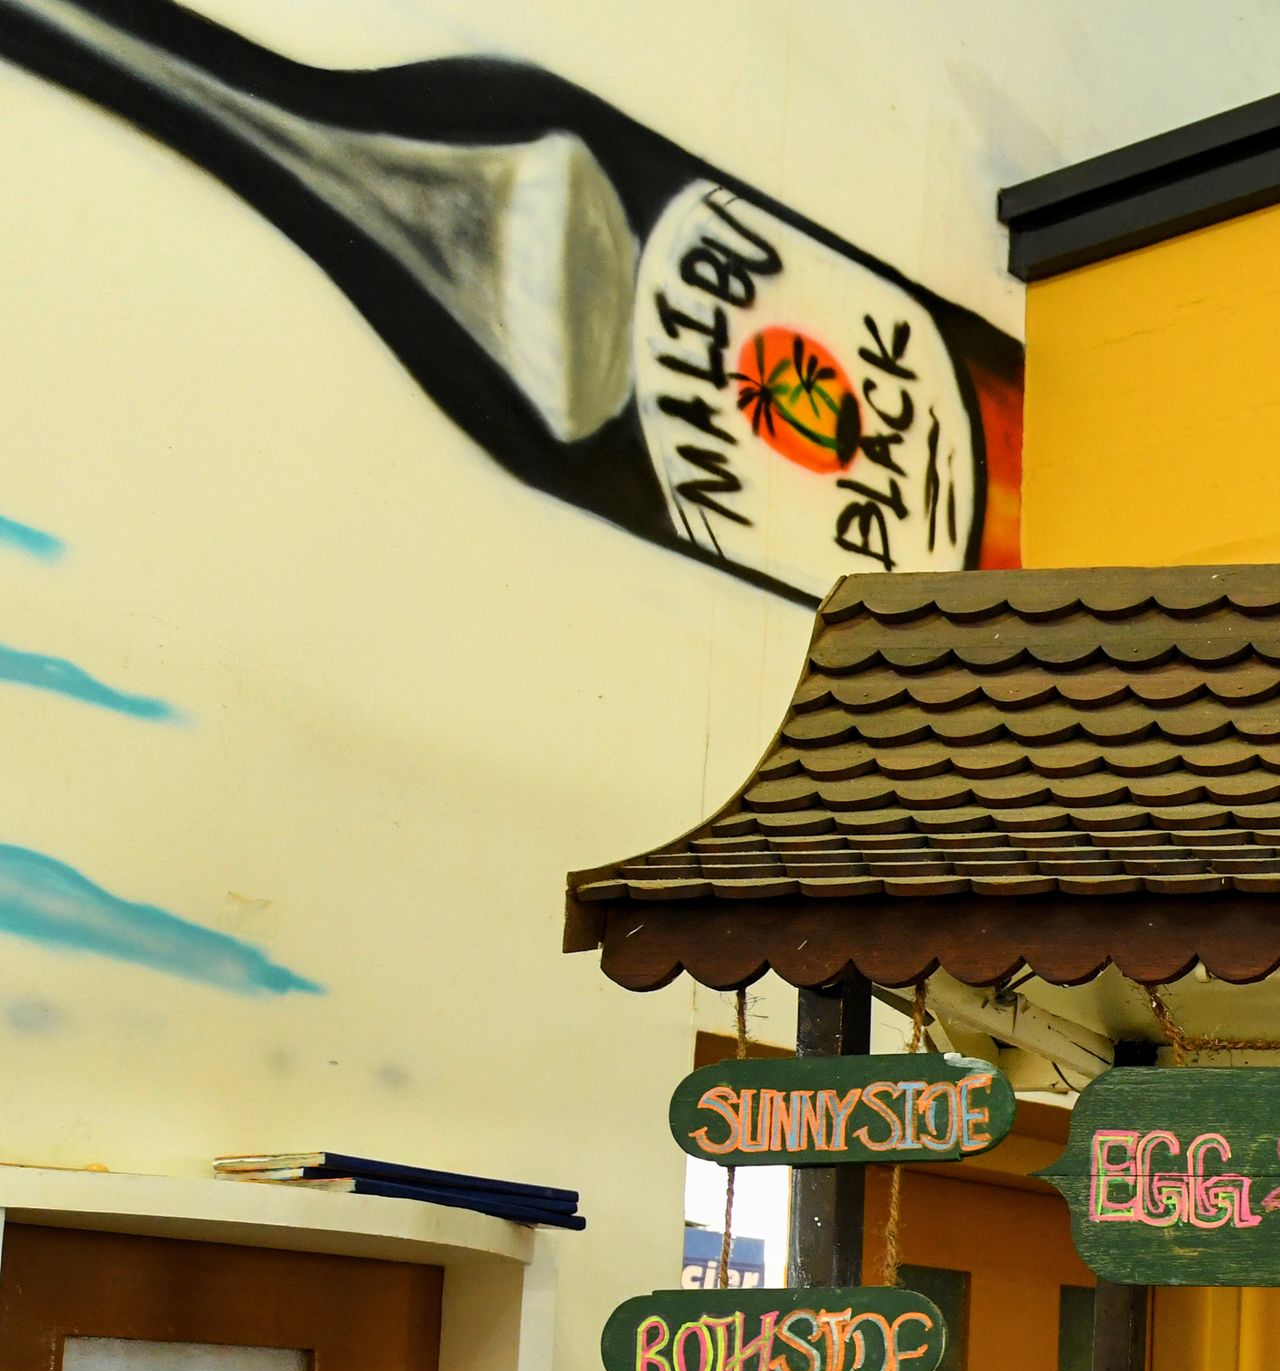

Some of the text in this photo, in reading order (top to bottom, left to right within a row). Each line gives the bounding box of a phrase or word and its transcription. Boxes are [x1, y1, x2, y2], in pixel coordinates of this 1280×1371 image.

[655, 195, 784, 527] MALIBU
[834, 314, 917, 572] BLACK
[1088, 1129, 1263, 1228] EGG
